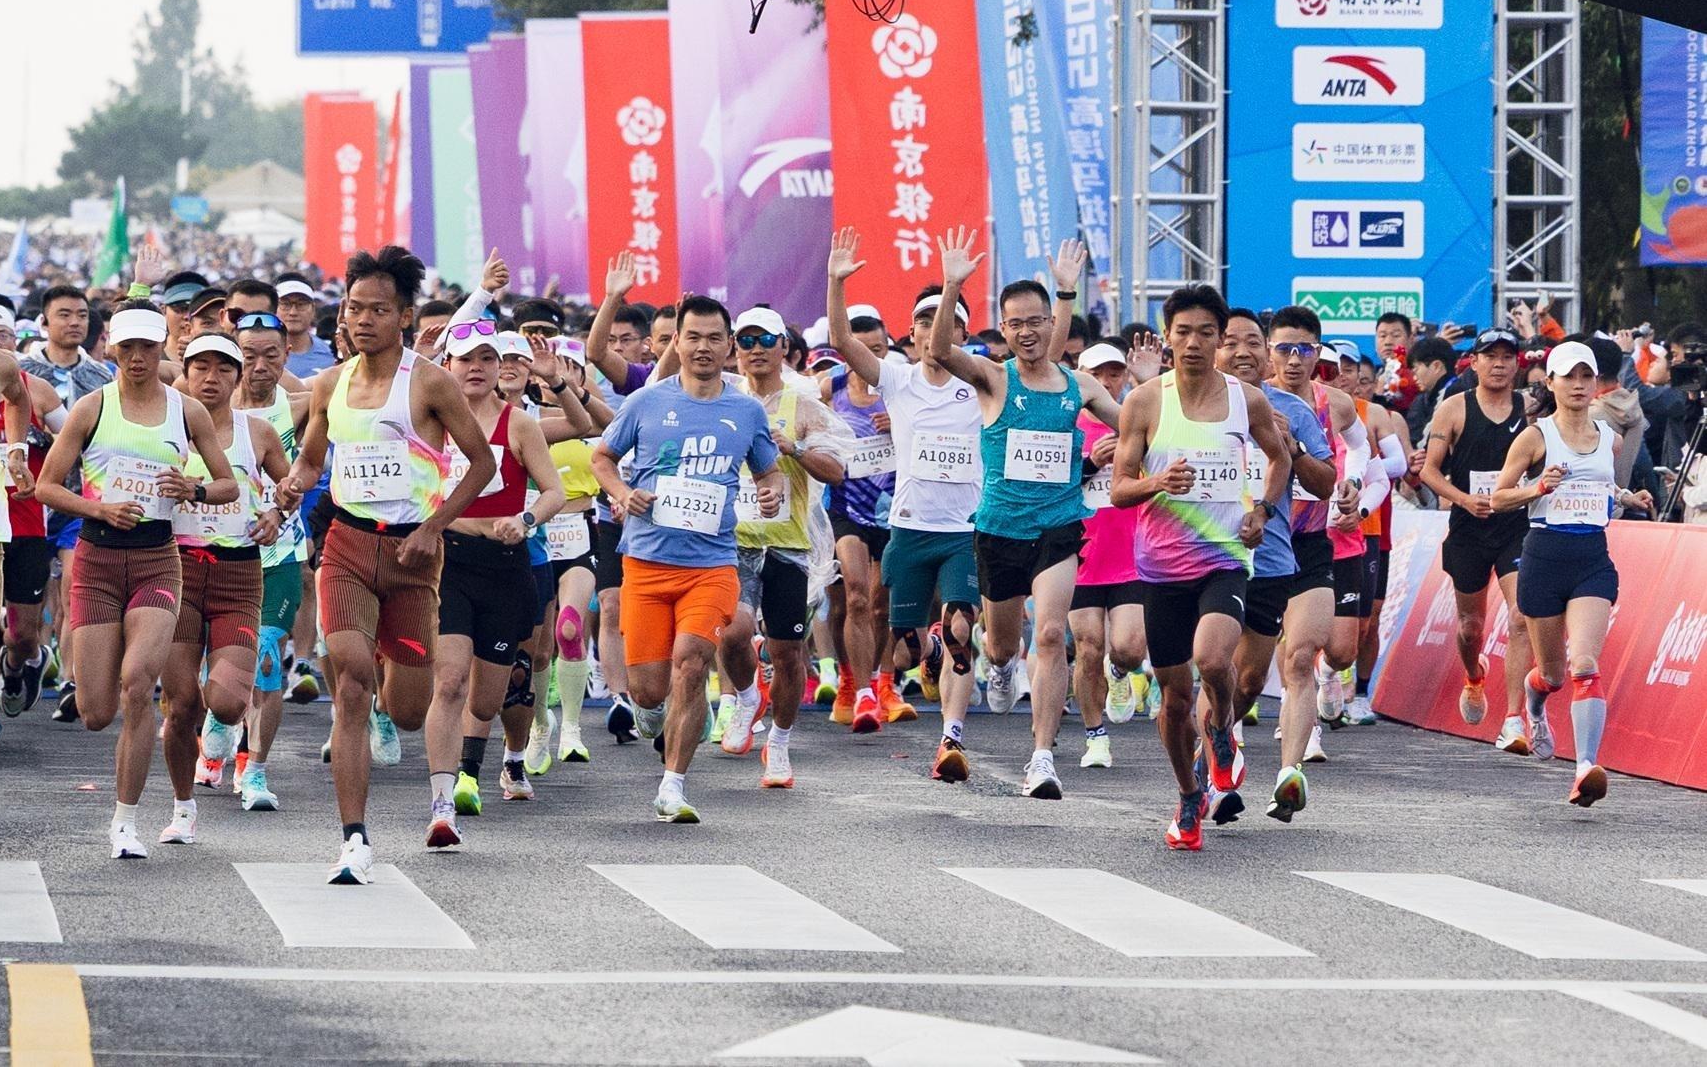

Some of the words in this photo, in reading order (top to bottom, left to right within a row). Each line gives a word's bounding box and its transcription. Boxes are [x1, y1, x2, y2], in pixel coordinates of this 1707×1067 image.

[1321, 79, 1367, 97] ANTA
[1334, 144, 1416, 156] 中国体育彩票
[1337, 296, 1418, 318] 众安保险
[918, 449, 973, 464] A10881
[1013, 449, 1067, 463] A10591
[344, 462, 403, 480] A11142
[685, 456, 733, 475] HUN
[1197, 468, 1238, 482] 1140
[661, 495, 718, 516] A12321
[1553, 497, 1605, 511] A20080
[549, 529, 584, 543] 0005
